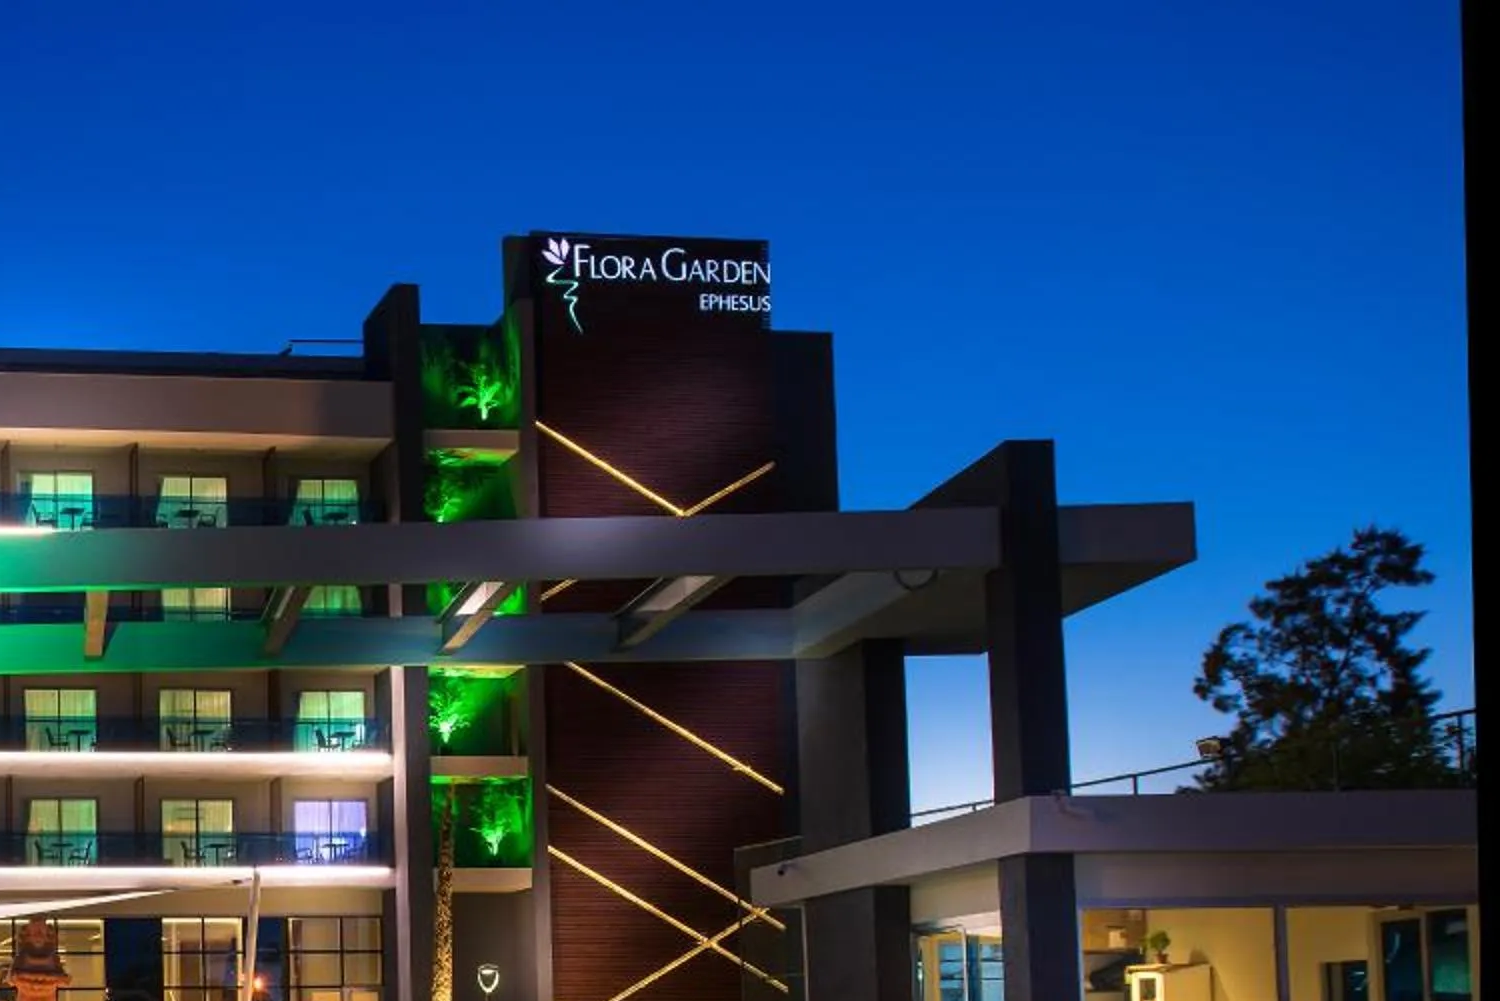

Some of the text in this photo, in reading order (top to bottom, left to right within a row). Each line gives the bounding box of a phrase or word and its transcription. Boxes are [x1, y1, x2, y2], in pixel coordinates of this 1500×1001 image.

[573, 244, 771, 285] FLORA GARDEN
[700, 294, 771, 312] EPHESUS
